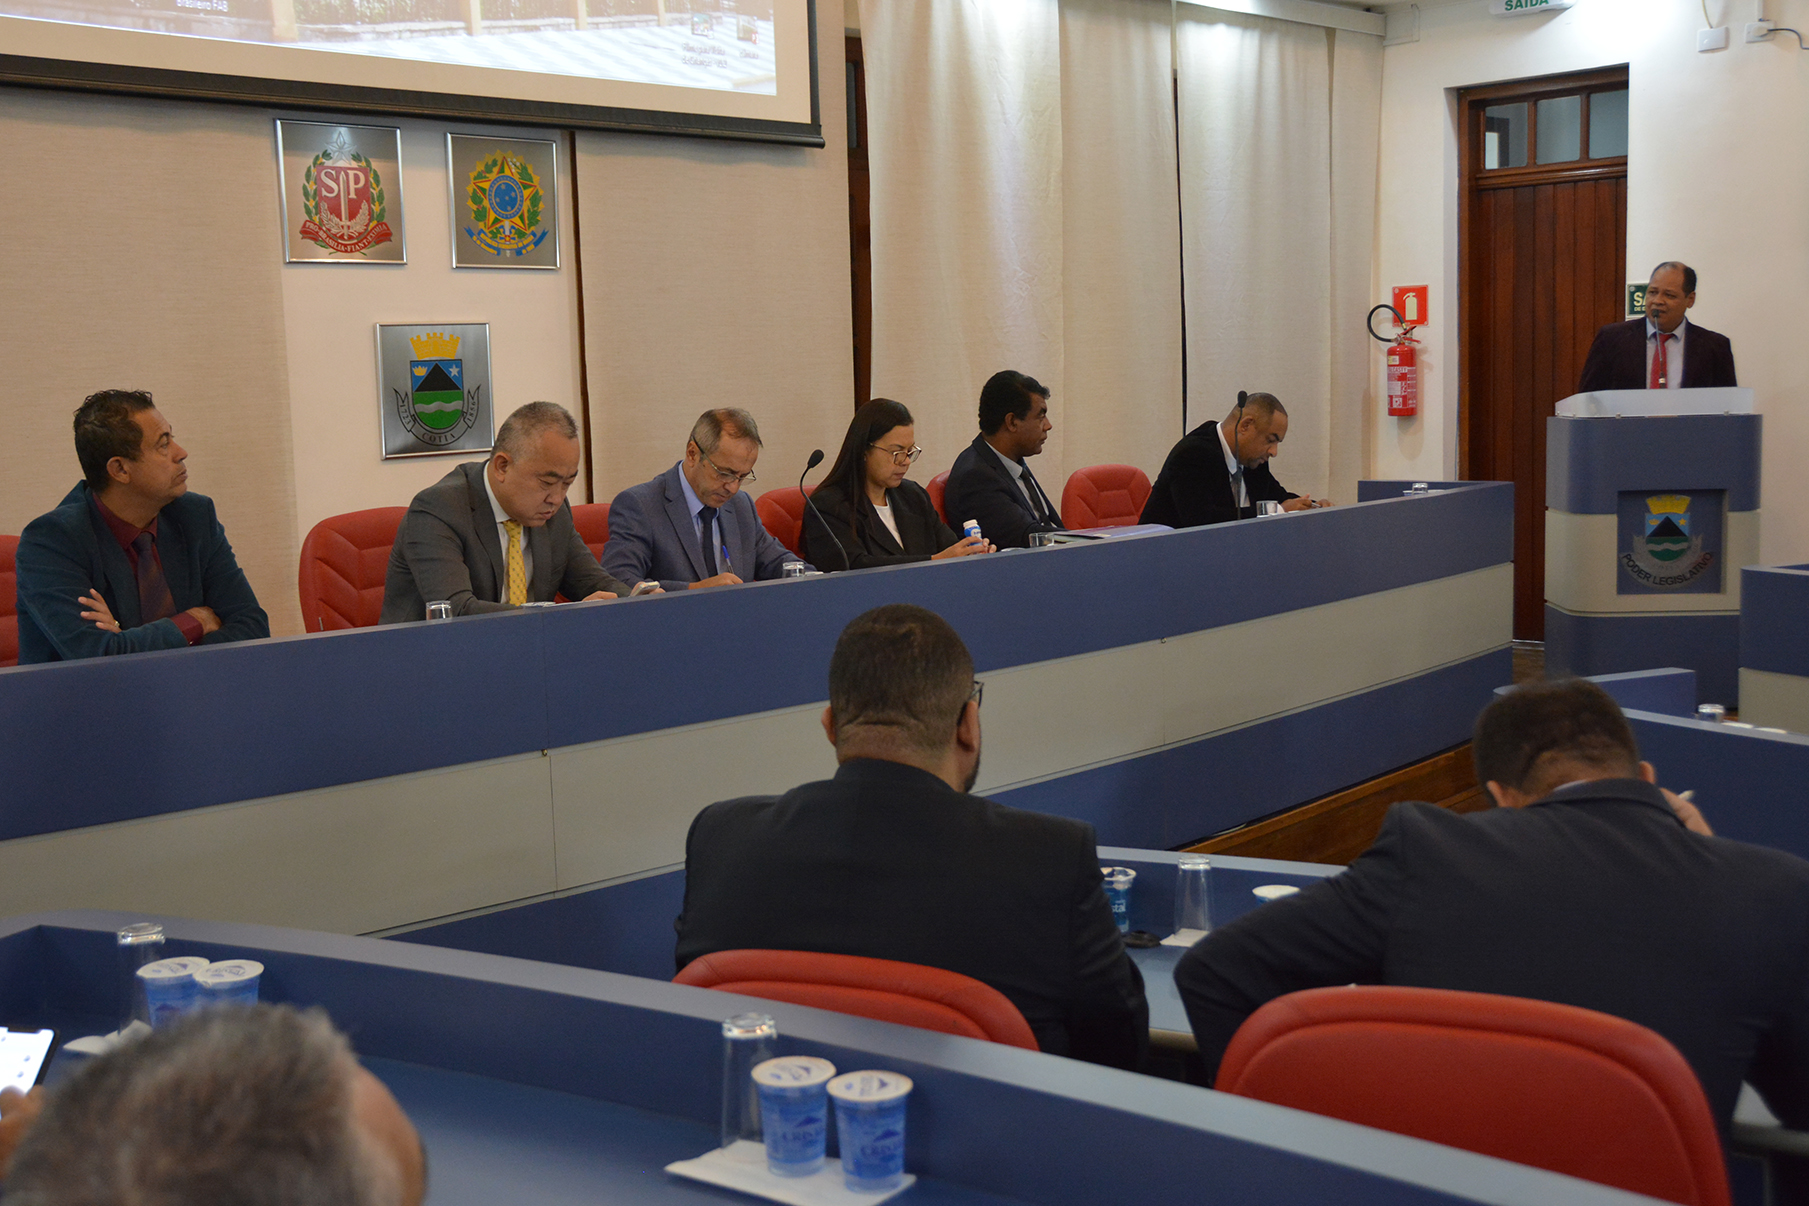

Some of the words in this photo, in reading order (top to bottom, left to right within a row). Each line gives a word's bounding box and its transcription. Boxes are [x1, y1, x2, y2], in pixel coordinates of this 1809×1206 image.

[422, 432, 456, 443] COTIA
[1622, 553, 1652, 582] PODER
[1652, 552, 1713, 586] LEGISLATIVO
